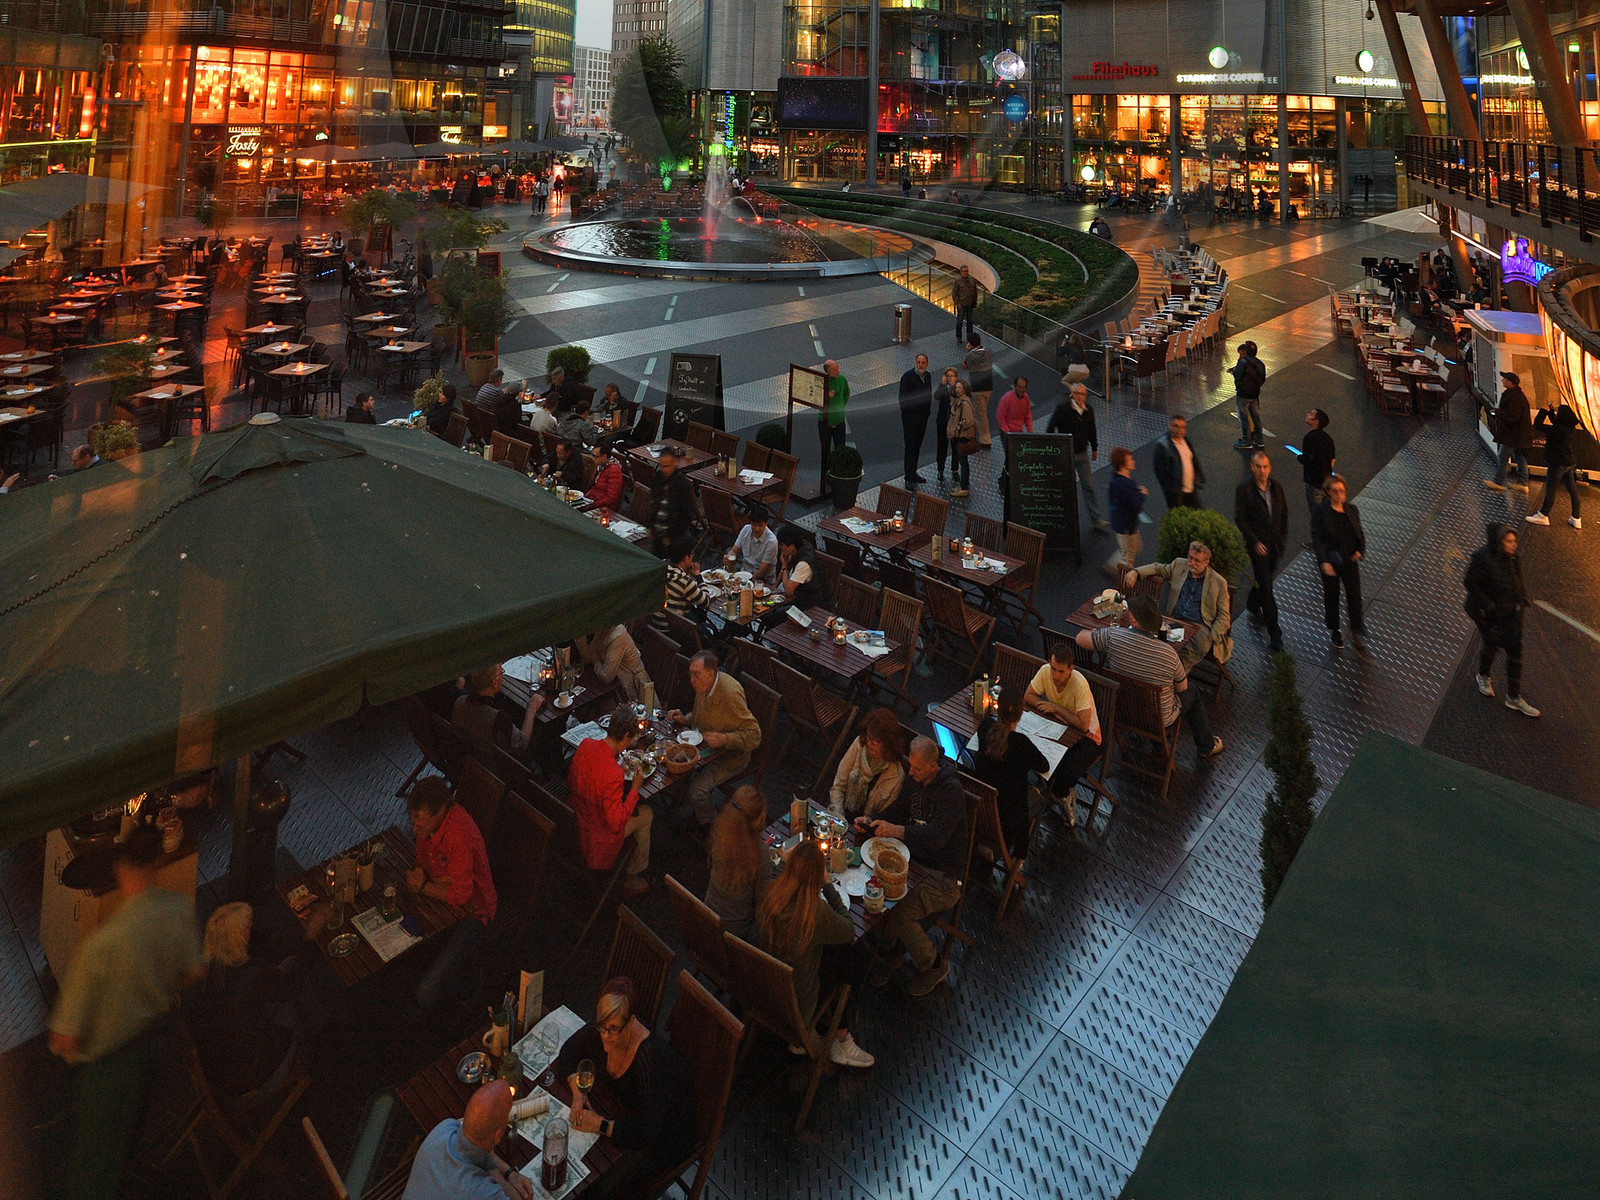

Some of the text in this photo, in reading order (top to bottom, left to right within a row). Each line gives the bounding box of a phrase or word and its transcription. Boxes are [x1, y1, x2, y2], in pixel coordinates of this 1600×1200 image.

[1092, 61, 1159, 76] Filmhaus
[1177, 74, 1229, 82] STARBUCKS
[226, 134, 260, 156] Josty
